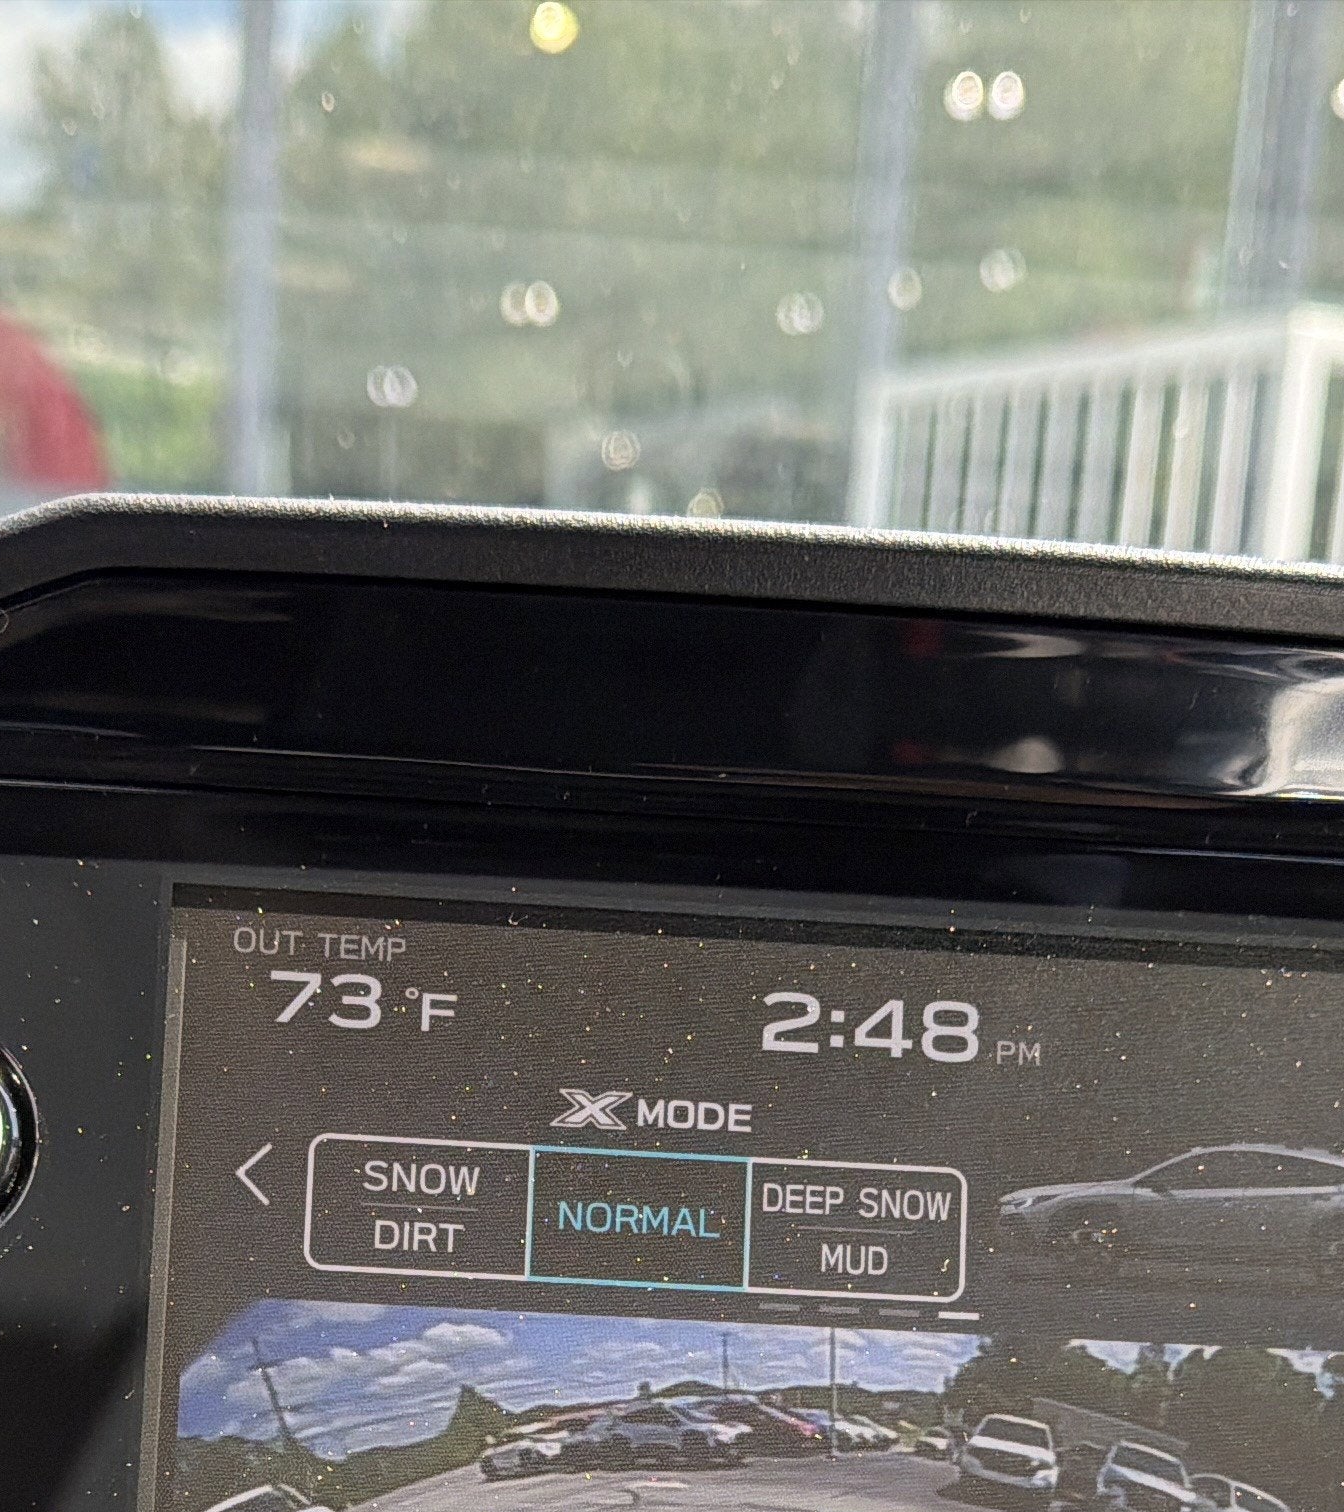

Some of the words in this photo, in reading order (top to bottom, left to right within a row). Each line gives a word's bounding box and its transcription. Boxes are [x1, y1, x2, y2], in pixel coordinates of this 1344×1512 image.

[233, 927, 301, 957] OUT
[317, 932, 407, 963] TEMP
[271, 968, 382, 1030] 73
[761, 992, 981, 1063] 2:48
[996, 1040, 1042, 1068] PM
[636, 1098, 754, 1134] MODE
[362, 1159, 481, 1198] SNOW
[557, 1199, 720, 1240] NORMAL
[762, 1182, 844, 1217] DEEP
[859, 1188, 952, 1223] SNOW
[373, 1219, 465, 1254] DIRT
[821, 1242, 889, 1278] MUD
